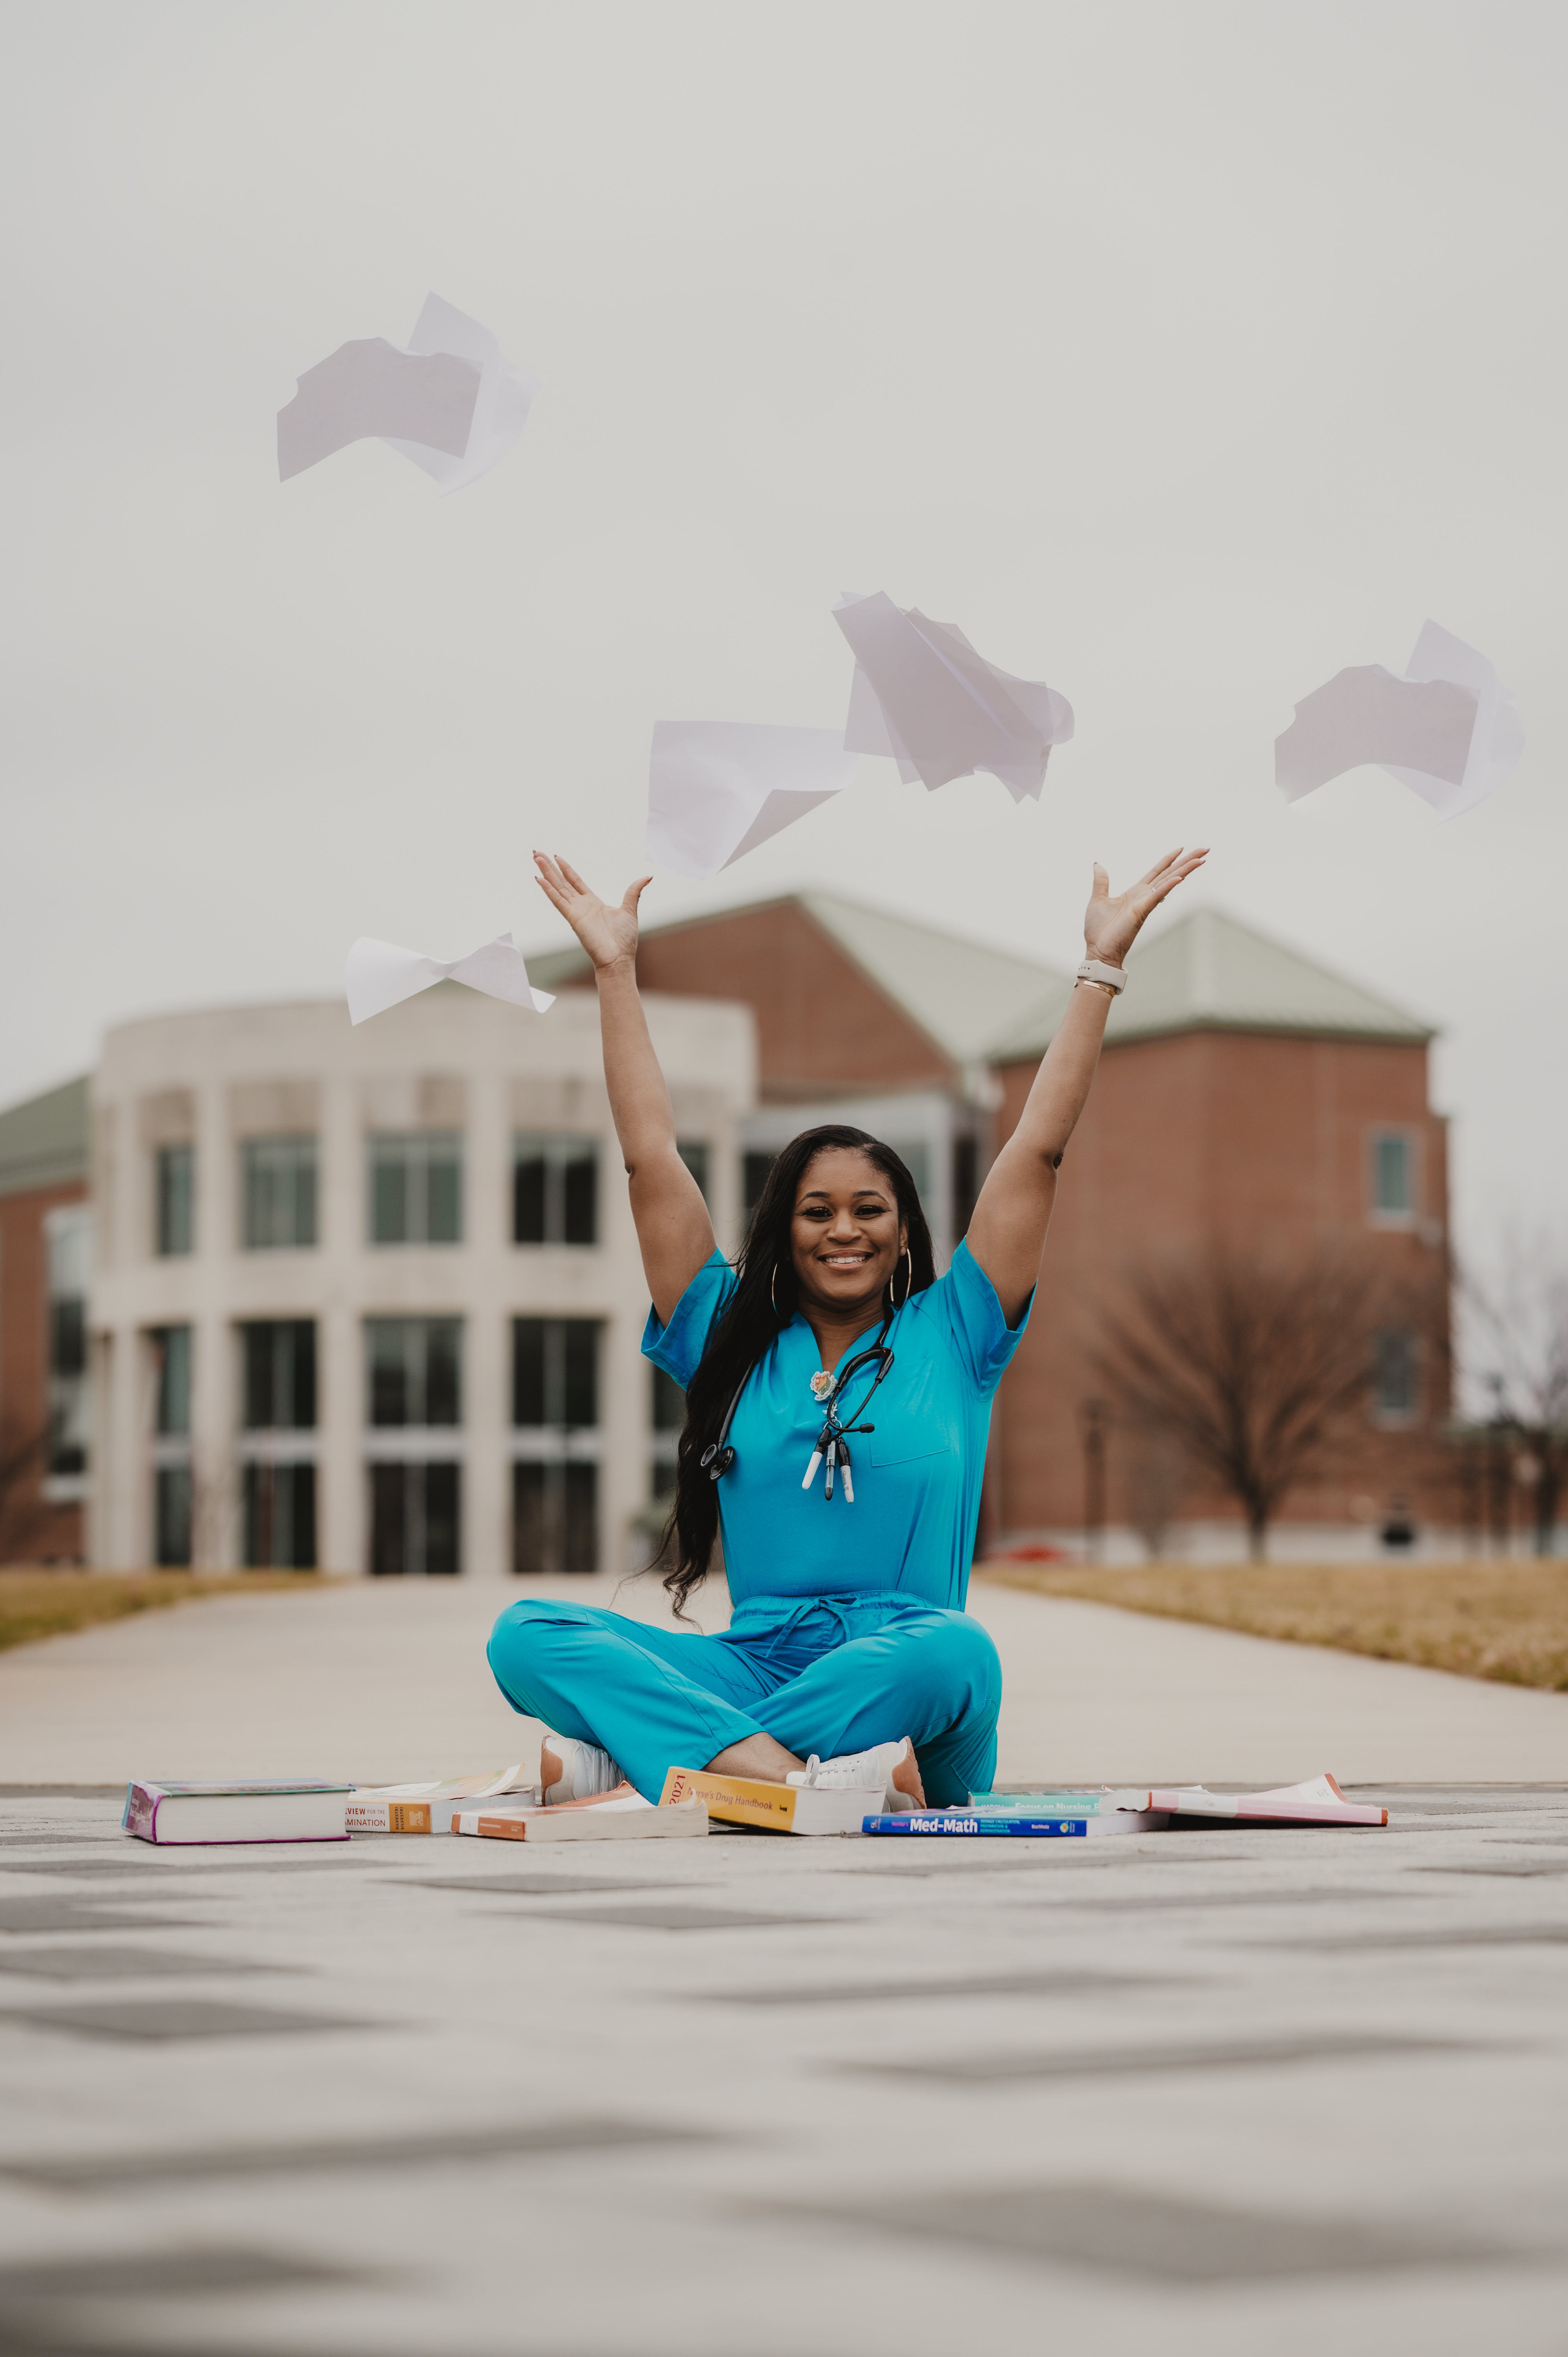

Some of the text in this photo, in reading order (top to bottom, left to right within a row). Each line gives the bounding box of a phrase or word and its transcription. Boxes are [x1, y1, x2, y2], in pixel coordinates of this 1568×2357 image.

[669, 1775, 686, 1805] 2021
[687, 1787, 773, 1810] Nrse's Drug Handbook
[910, 1818, 978, 1833] Med-Math
